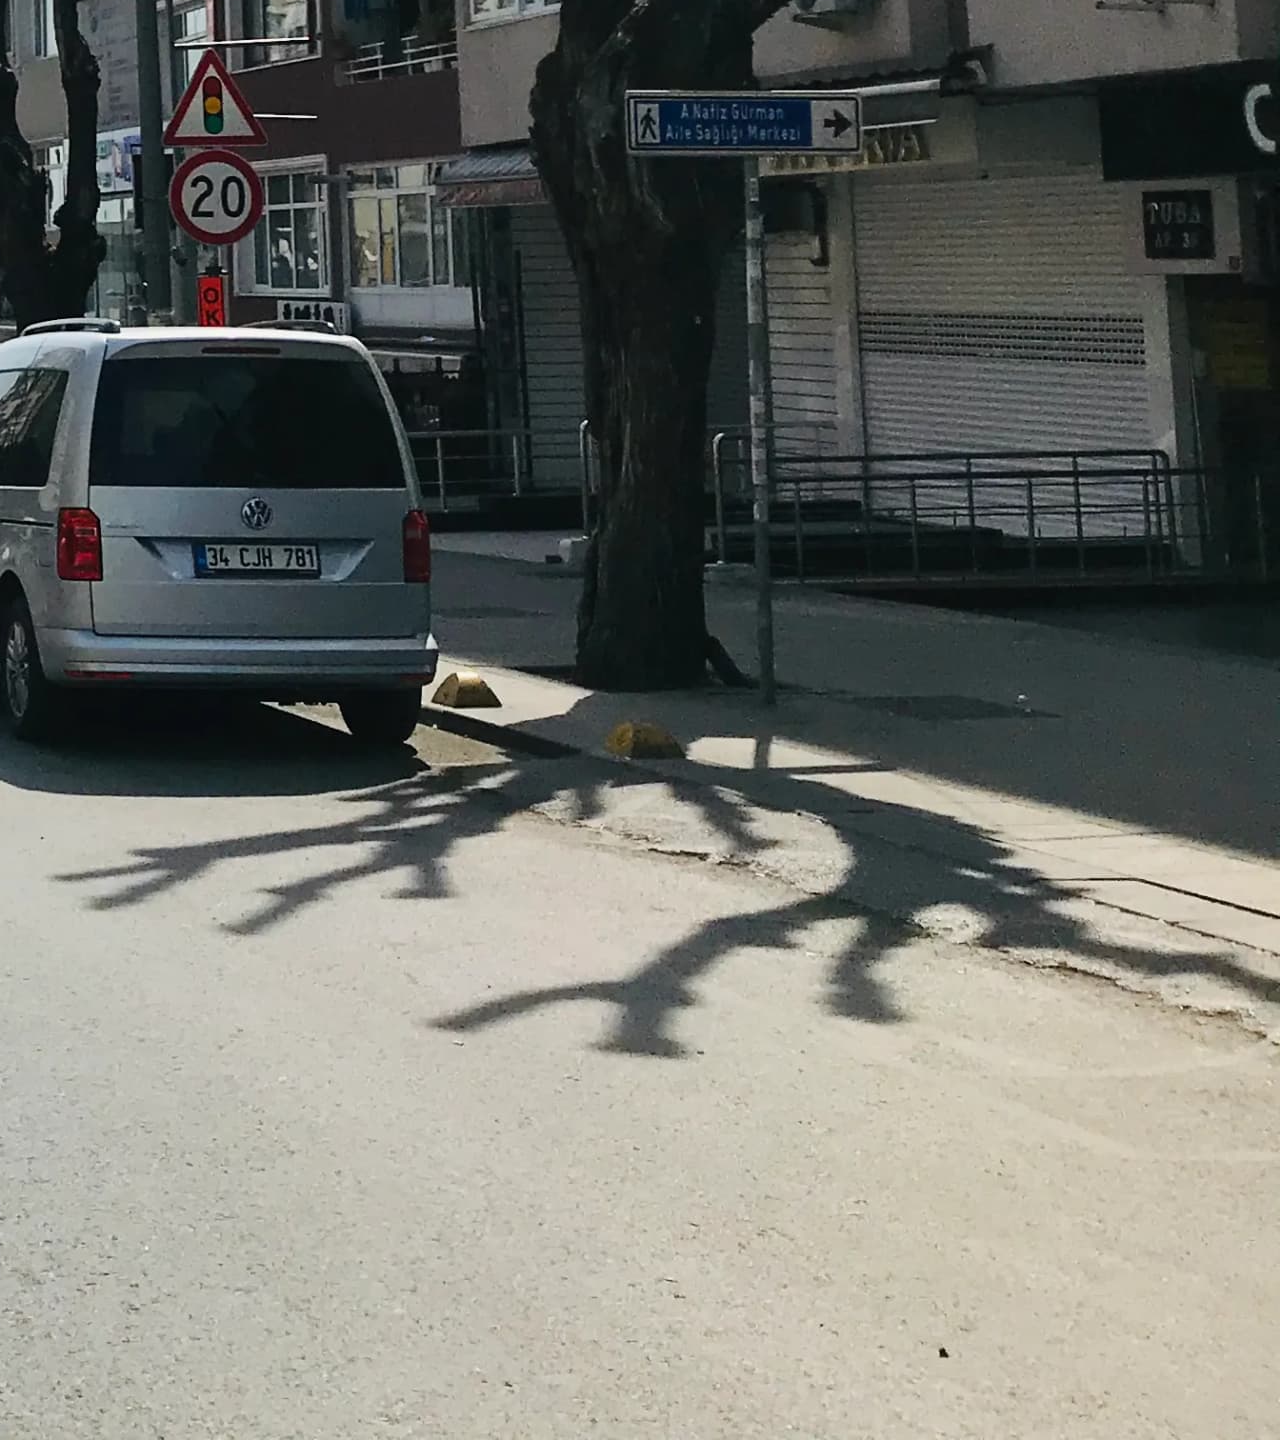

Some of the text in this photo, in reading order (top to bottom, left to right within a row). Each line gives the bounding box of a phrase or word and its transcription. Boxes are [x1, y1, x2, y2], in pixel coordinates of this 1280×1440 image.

[665, 124, 692, 141] Aile
[190, 175, 246, 218] 20
[207, 547, 316, 568] 34 CJH 781
